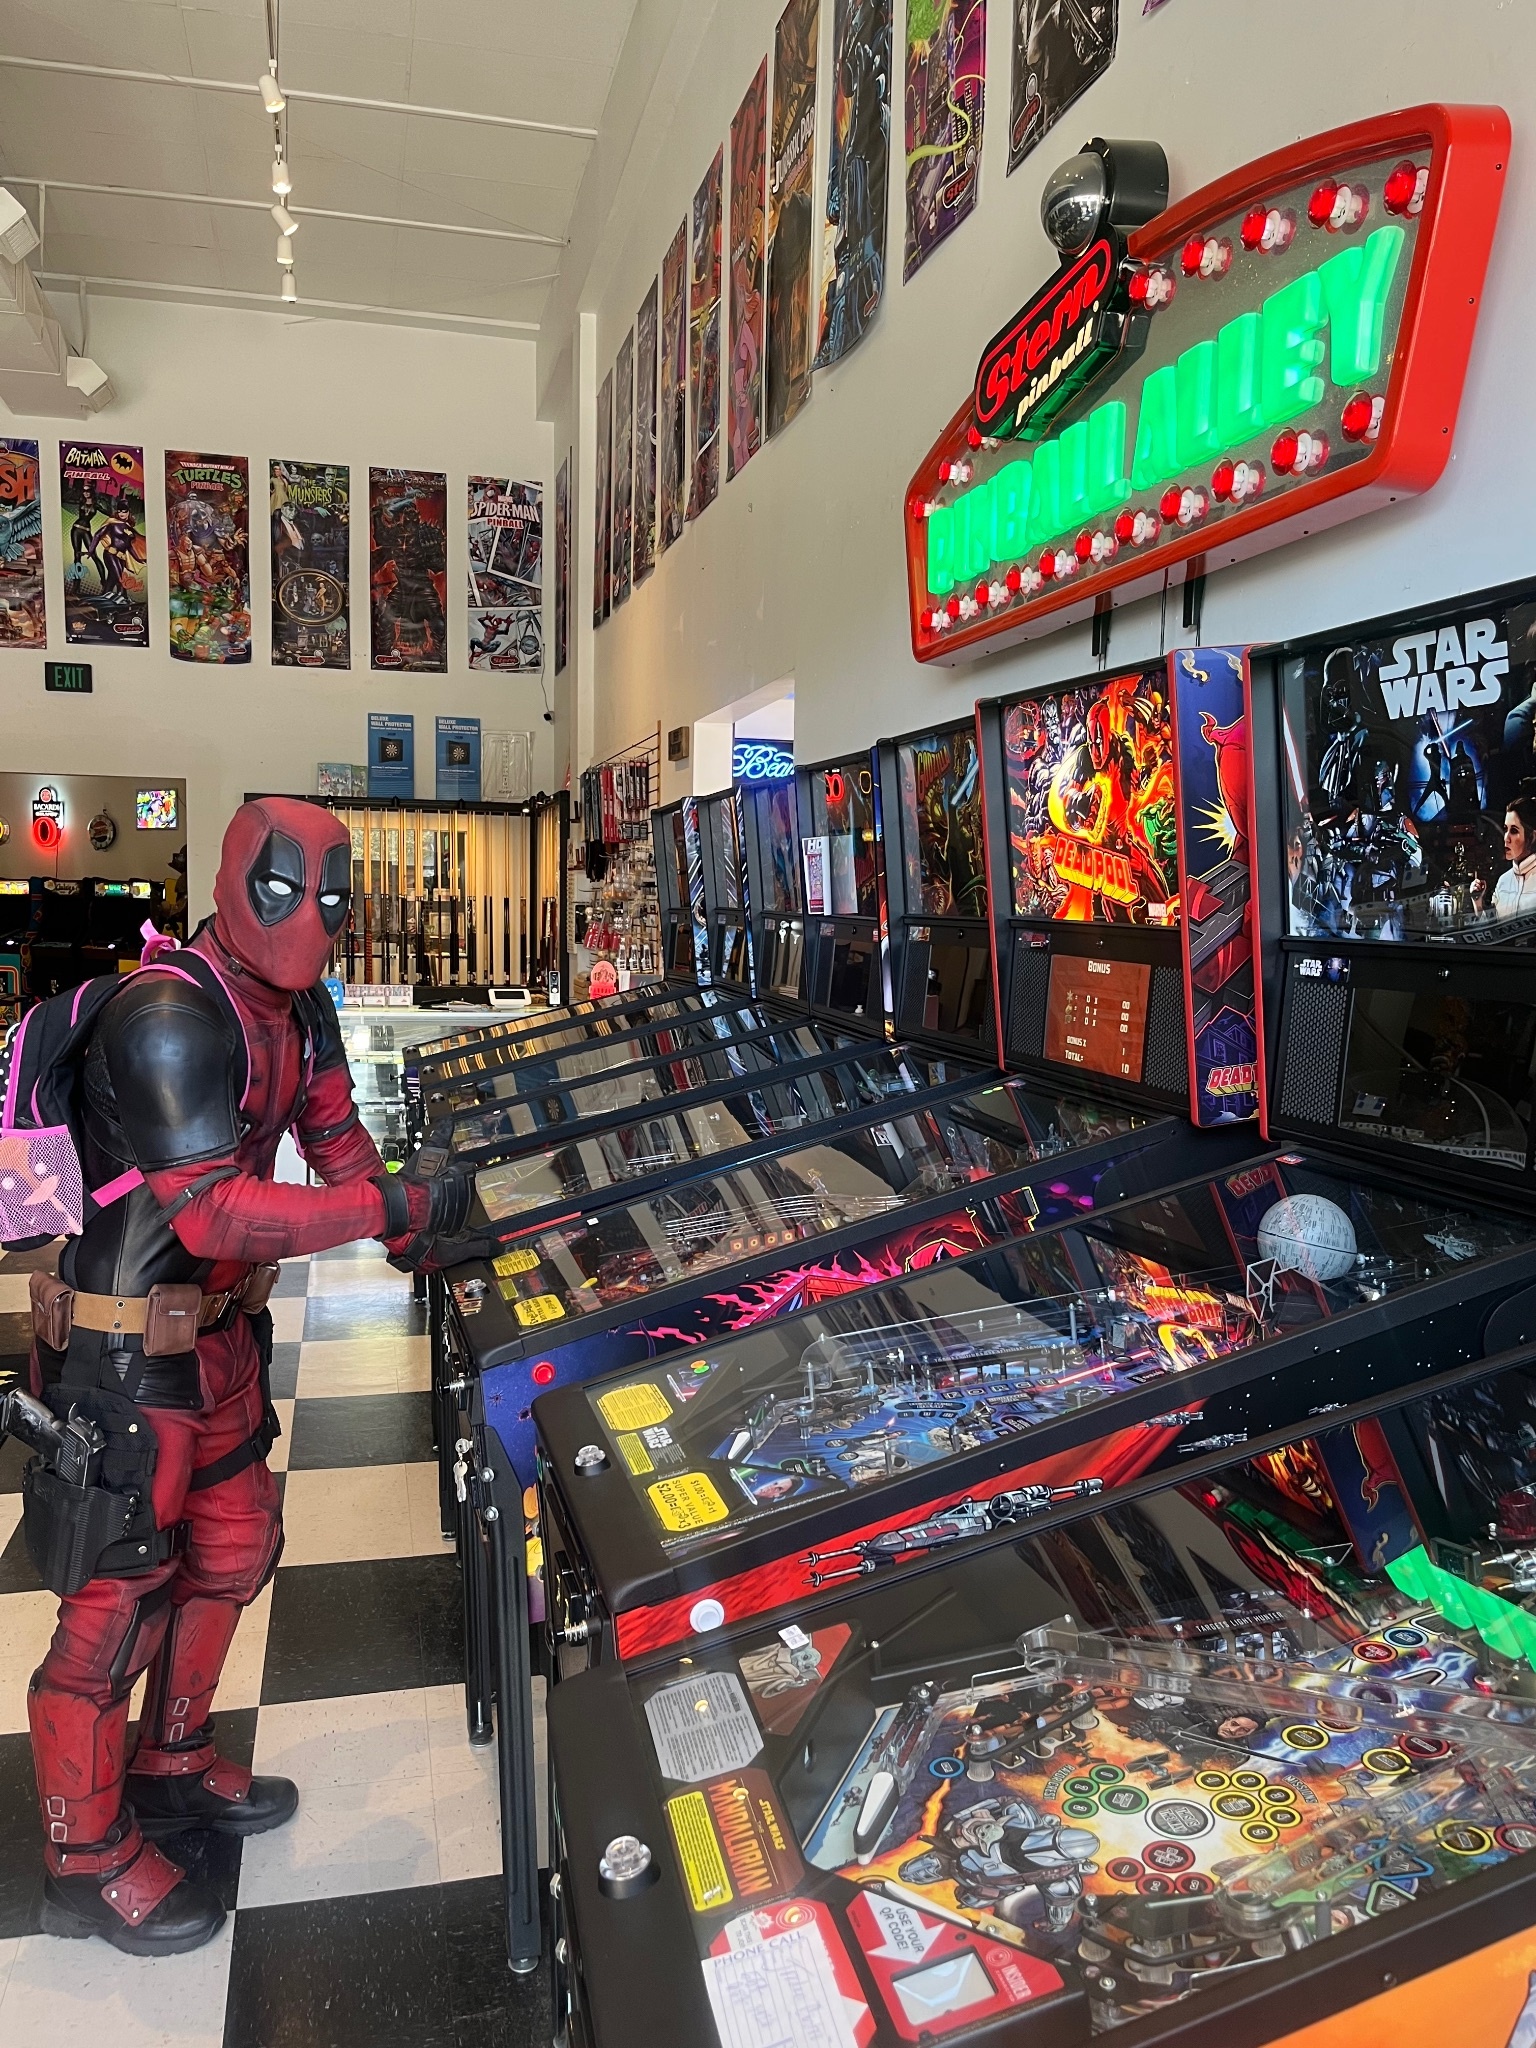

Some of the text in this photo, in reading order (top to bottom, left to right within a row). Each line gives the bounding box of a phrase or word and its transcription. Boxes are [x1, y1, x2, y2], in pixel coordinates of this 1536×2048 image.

[945, 169, 976, 200] Stern
[985, 262, 1099, 410] Stern
[1015, 317, 1094, 427] pinball
[927, 225, 1405, 595] PINBALL ALLEY
[65, 447, 109, 467] BATMAN
[64, 470, 111, 481] PINBALL
[172, 469, 242, 489] TURTLES
[191, 481, 225, 492] PINBALL
[303, 479, 316, 487] THE
[287, 485, 333, 504] MUNSTERS
[472, 501, 540, 523] SPIDER-MAN
[487, 518, 524, 529] PINBALL
[1378, 617, 1509, 682] STAR
[54, 666, 84, 689] EXIT
[1379, 658, 1510, 720] WARS
[34, 803, 60, 811] BACARDI
[1053, 835, 1140, 904] DEADPOOL
[1088, 960, 1111, 974] BONUS
[1299, 958, 1323, 969] STAR
[1299, 967, 1323, 977] WARS
[346, 985, 411, 997] WELCOME
[1066, 1035, 1082, 1046] BONUS
[642, 1428, 662, 1449] WARS
[654, 1426, 674, 1447] STAR
[672, 1479, 689, 1502] SUPER
[686, 1502, 704, 1525] VALUE
[1195, 1611, 1284, 1633] TARGETS LIGHT HUNTER
[1282, 1774, 1319, 1804] MISSIONS
[759, 1798, 786, 1851] STAR WARS
[708, 1779, 772, 1897] MANDALORIAN
[879, 1906, 910, 1950] QR CODE!
[895, 1907, 924, 1954] USE YOUR
[714, 1931, 803, 1968] PHONE CALL
[1001, 1963, 1032, 2000] INSIDER
